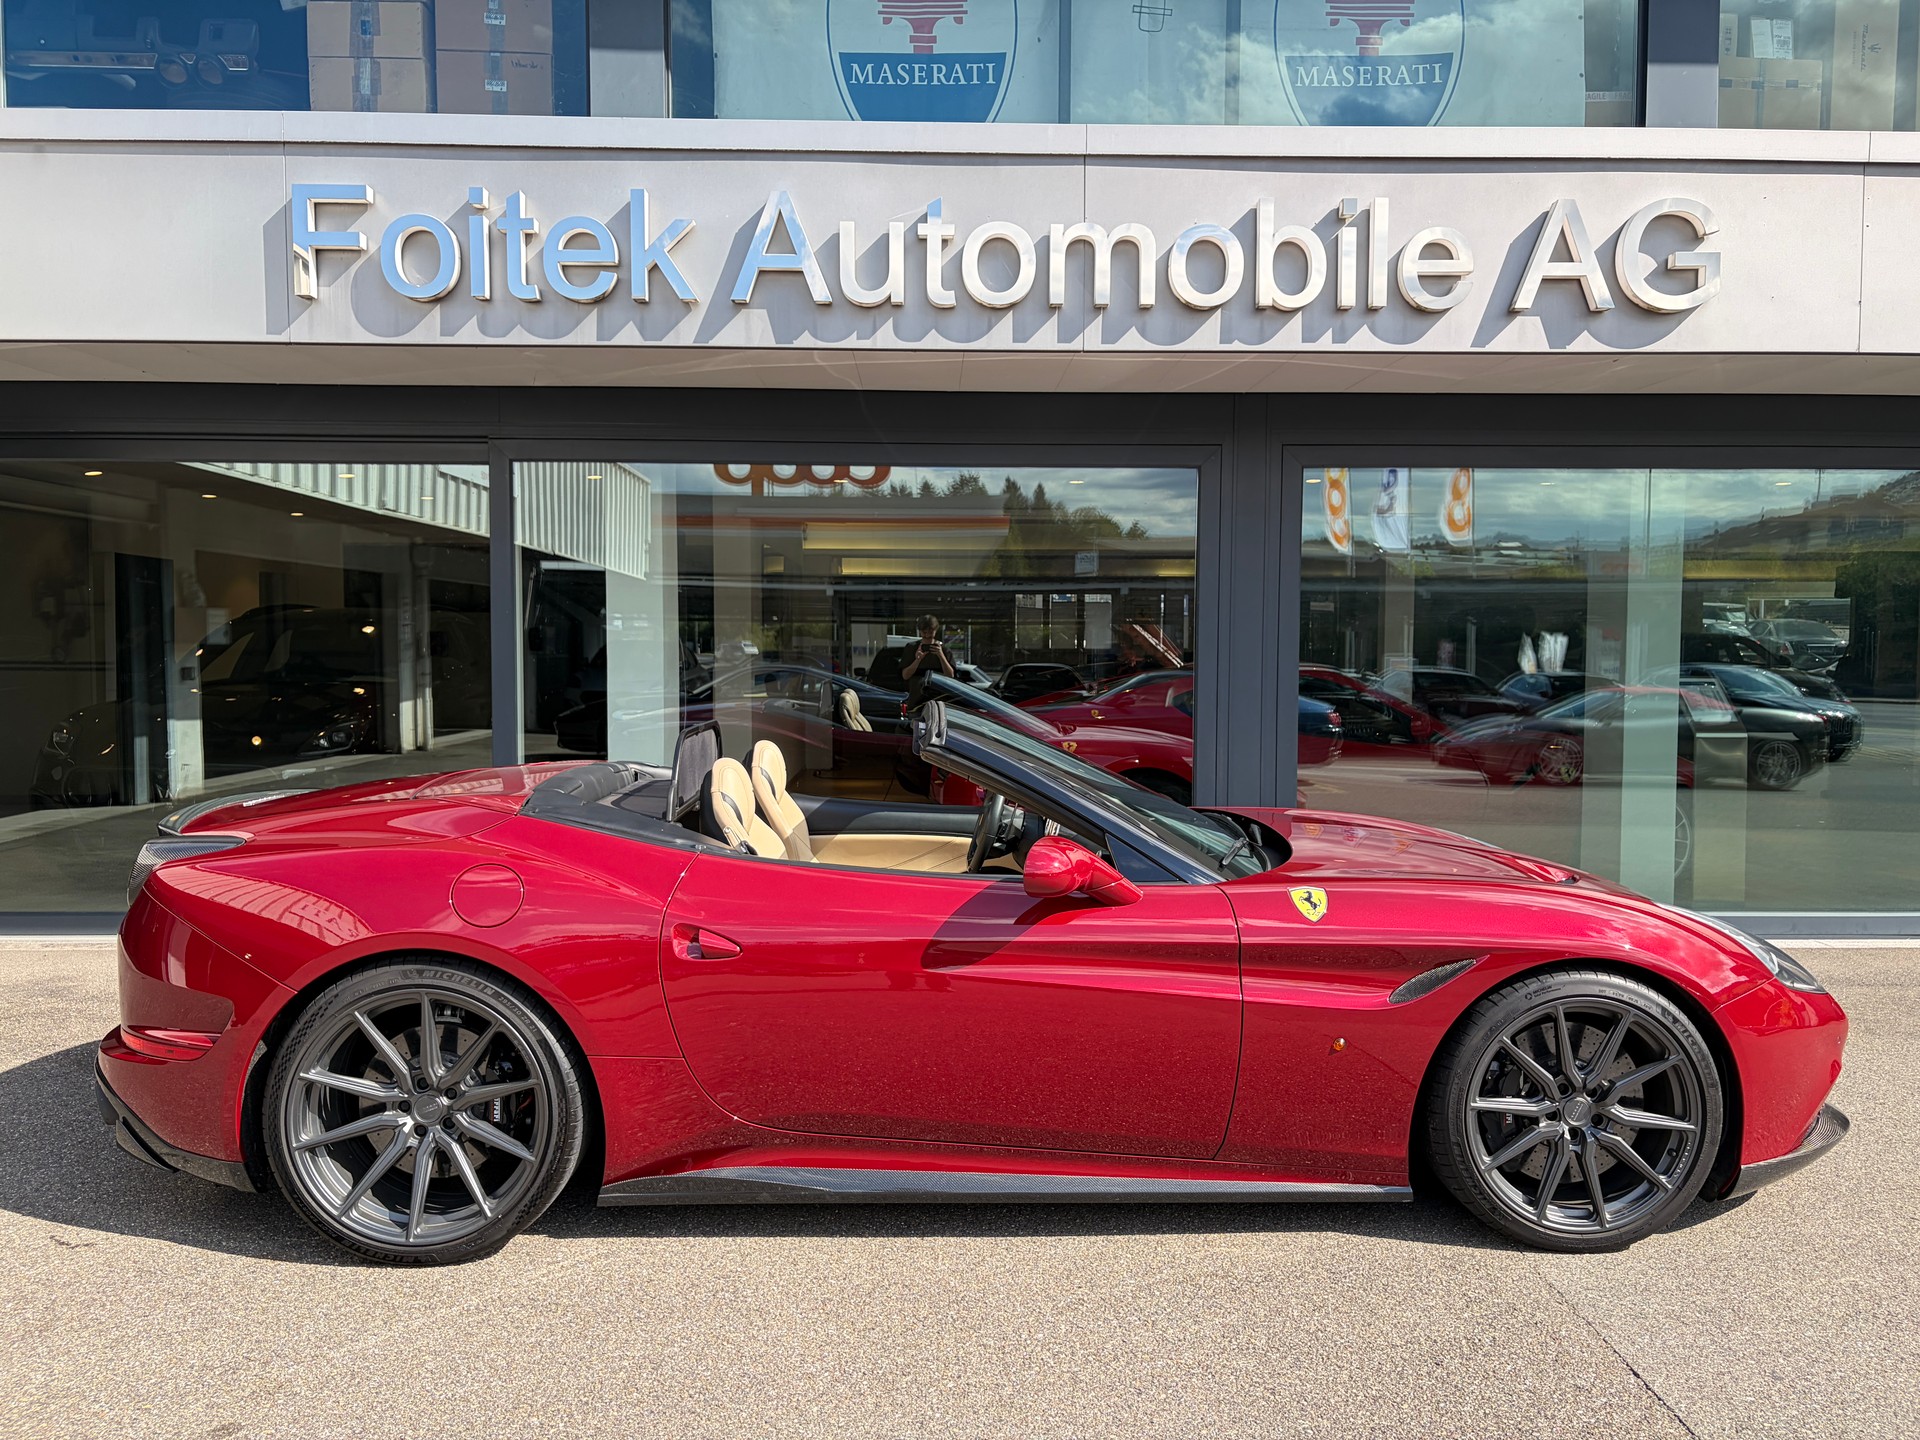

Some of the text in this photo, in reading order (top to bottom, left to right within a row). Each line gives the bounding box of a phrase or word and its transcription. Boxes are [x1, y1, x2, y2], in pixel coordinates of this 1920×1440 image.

[850, 63, 996, 85] MASERATI
[1295, 63, 1443, 87] MASERATI
[292, 184, 1722, 314] Foitek Automobile AG
[422, 970, 496, 996] MICHELIN
